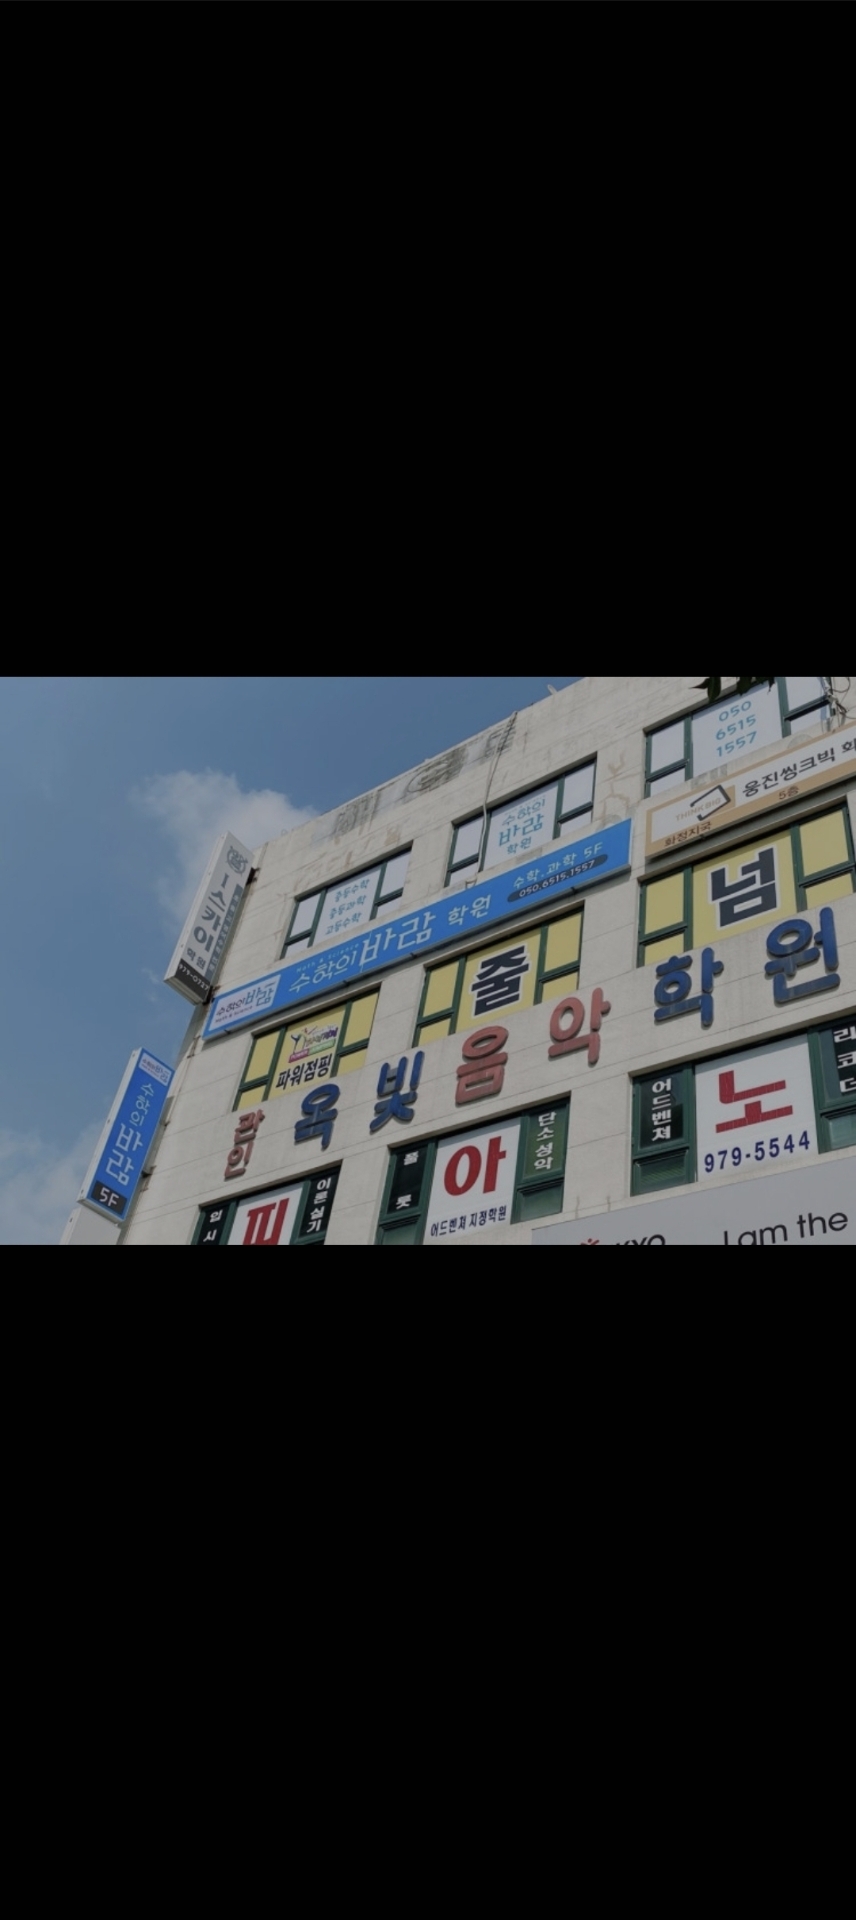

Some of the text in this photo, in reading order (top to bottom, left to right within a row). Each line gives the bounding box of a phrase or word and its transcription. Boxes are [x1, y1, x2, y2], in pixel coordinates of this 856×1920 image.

[719, 701, 752, 722] 050
[716, 714, 756, 740] 6515
[716, 731, 757, 757] 1557
[742, 747, 835, 798] 웅진씽크빅
[779, 785, 799, 800] 5층
[502, 799, 546, 826] 수학의
[499, 813, 544, 846] 바람
[665, 821, 711, 846] 화정지국
[507, 836, 532, 854] 학원
[584, 842, 603, 858] 5F
[335, 879, 370, 903] 중등수학
[519, 860, 595, 897] 050.6515.1557
[325, 912, 362, 935] 고등수학
[448, 894, 491, 926] 학원
[471, 847, 777, 1016] 줄 넘
[185, 947, 207, 970] 학원
[178, 963, 210, 991] 979-0727
[275, 1053, 333, 1090] 파워점핑
[715, 1069, 793, 1134] 노
[224, 1109, 265, 1181] 관인
[704, 1130, 810, 1173] 979-5544
[443, 1135, 507, 1197] 아
[99, 1187, 120, 1208] 5F
[241, 1197, 289, 1245] 피
[469, 1205, 507, 1227] 지정학원
[738, 1224, 788, 1245] am
[797, 1212, 848, 1238] the
